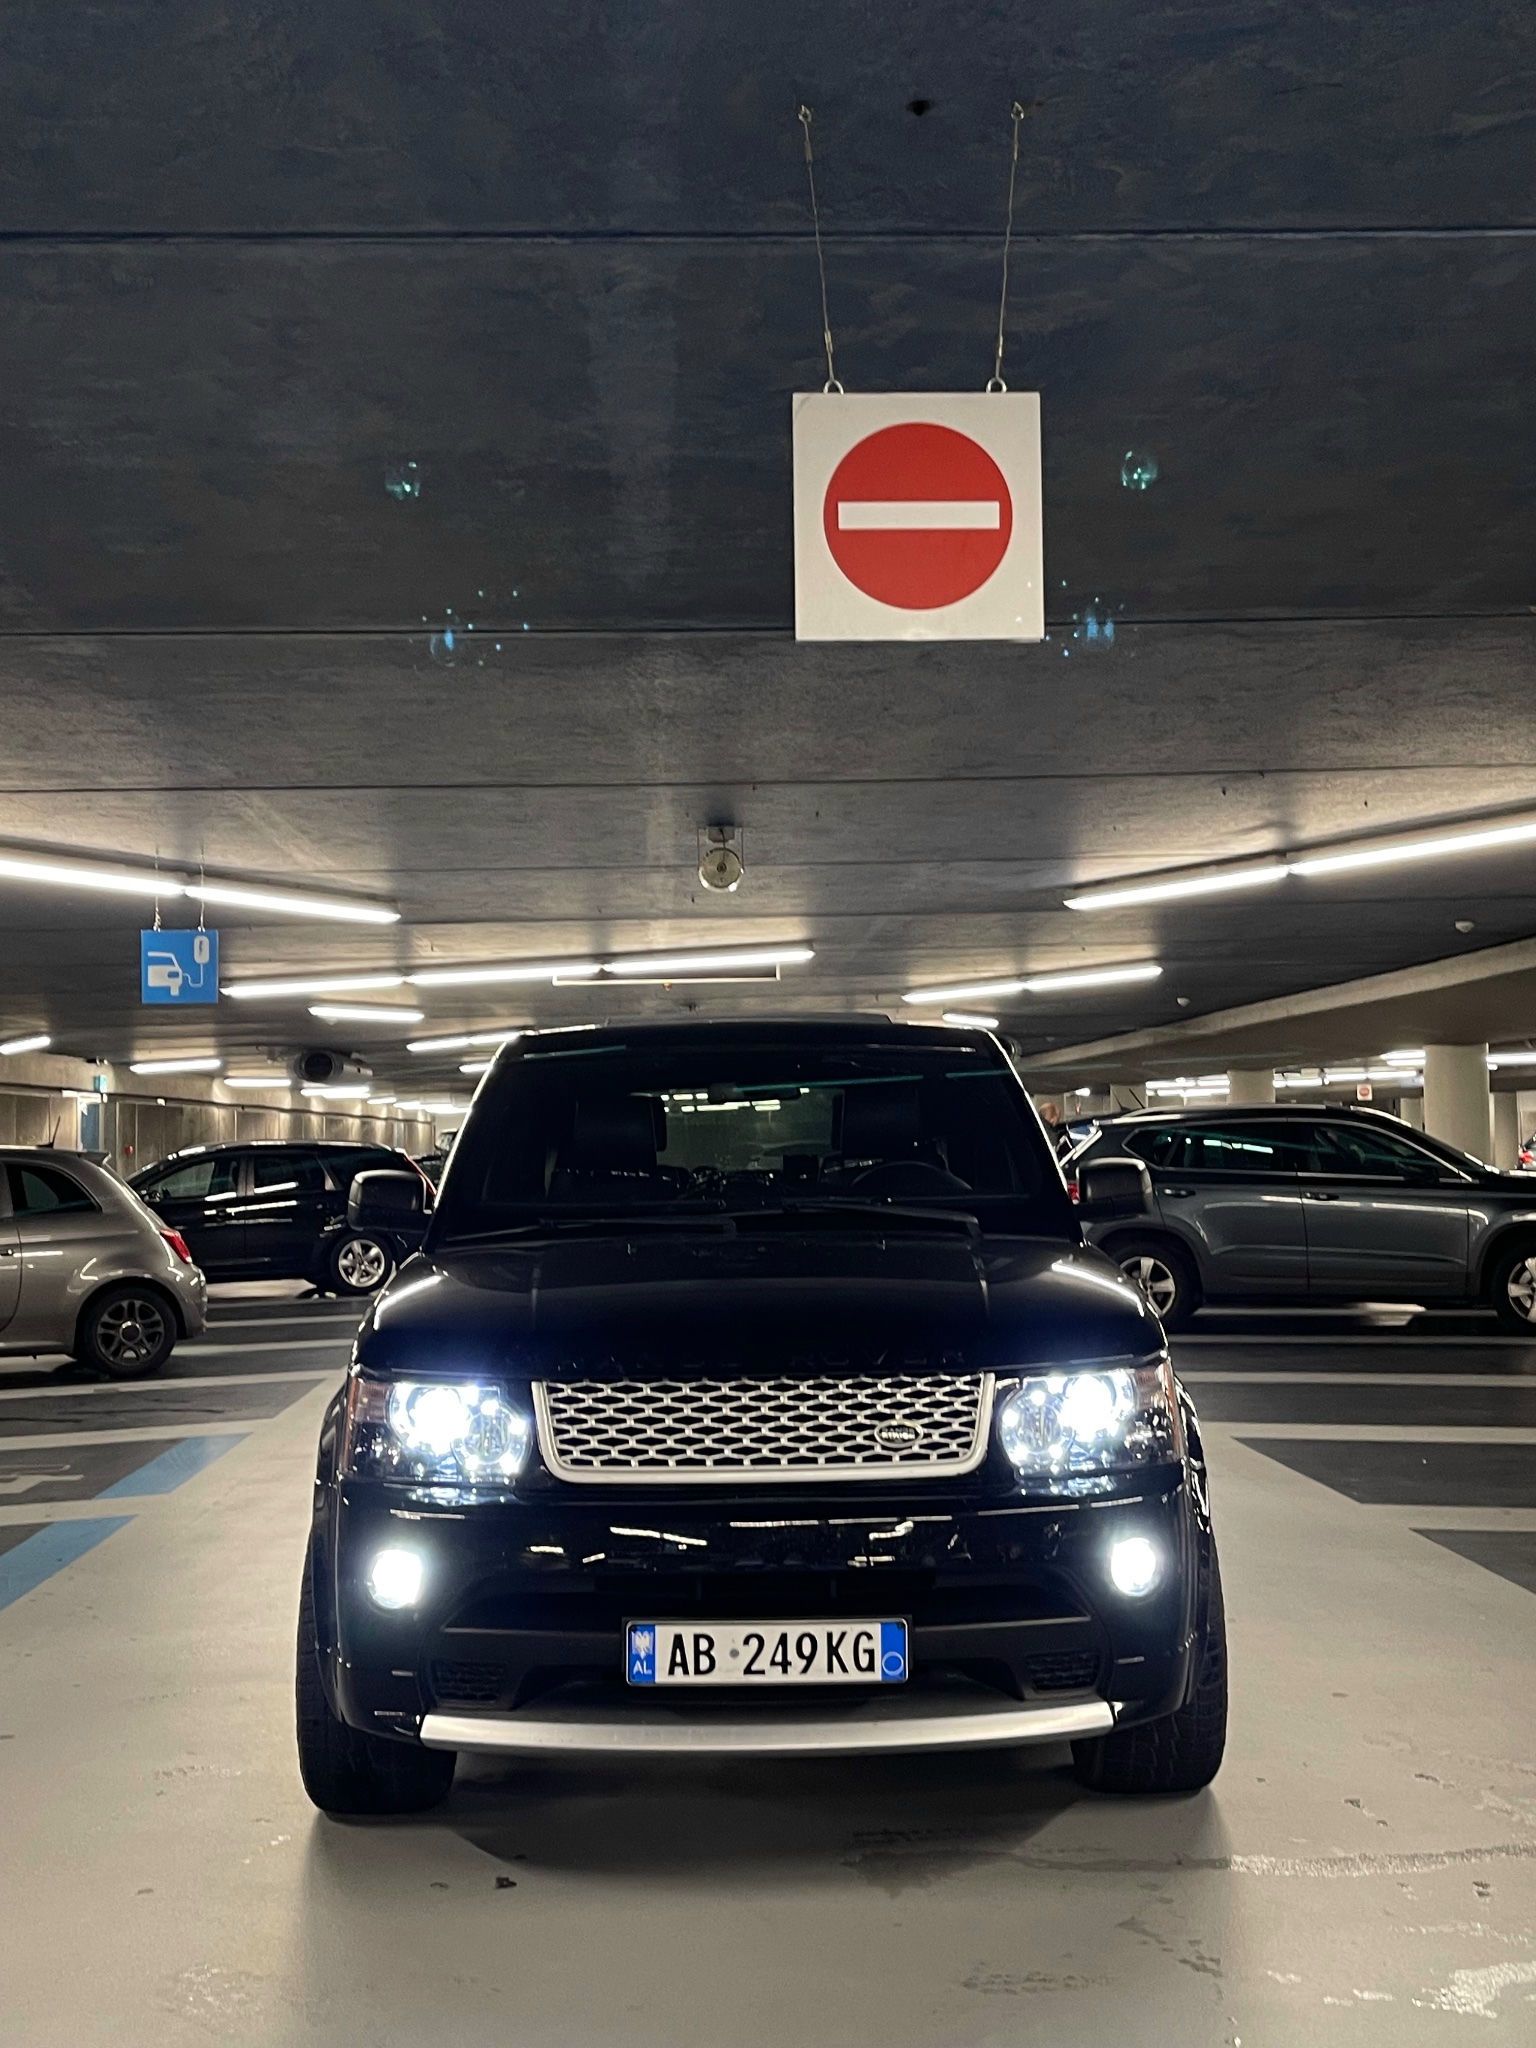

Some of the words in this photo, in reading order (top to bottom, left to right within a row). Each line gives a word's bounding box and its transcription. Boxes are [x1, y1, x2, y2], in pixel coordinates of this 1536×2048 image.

[633, 1660, 652, 1675] AL
[668, 1633, 716, 1676] AB
[743, 1630, 875, 1675] 249KG
